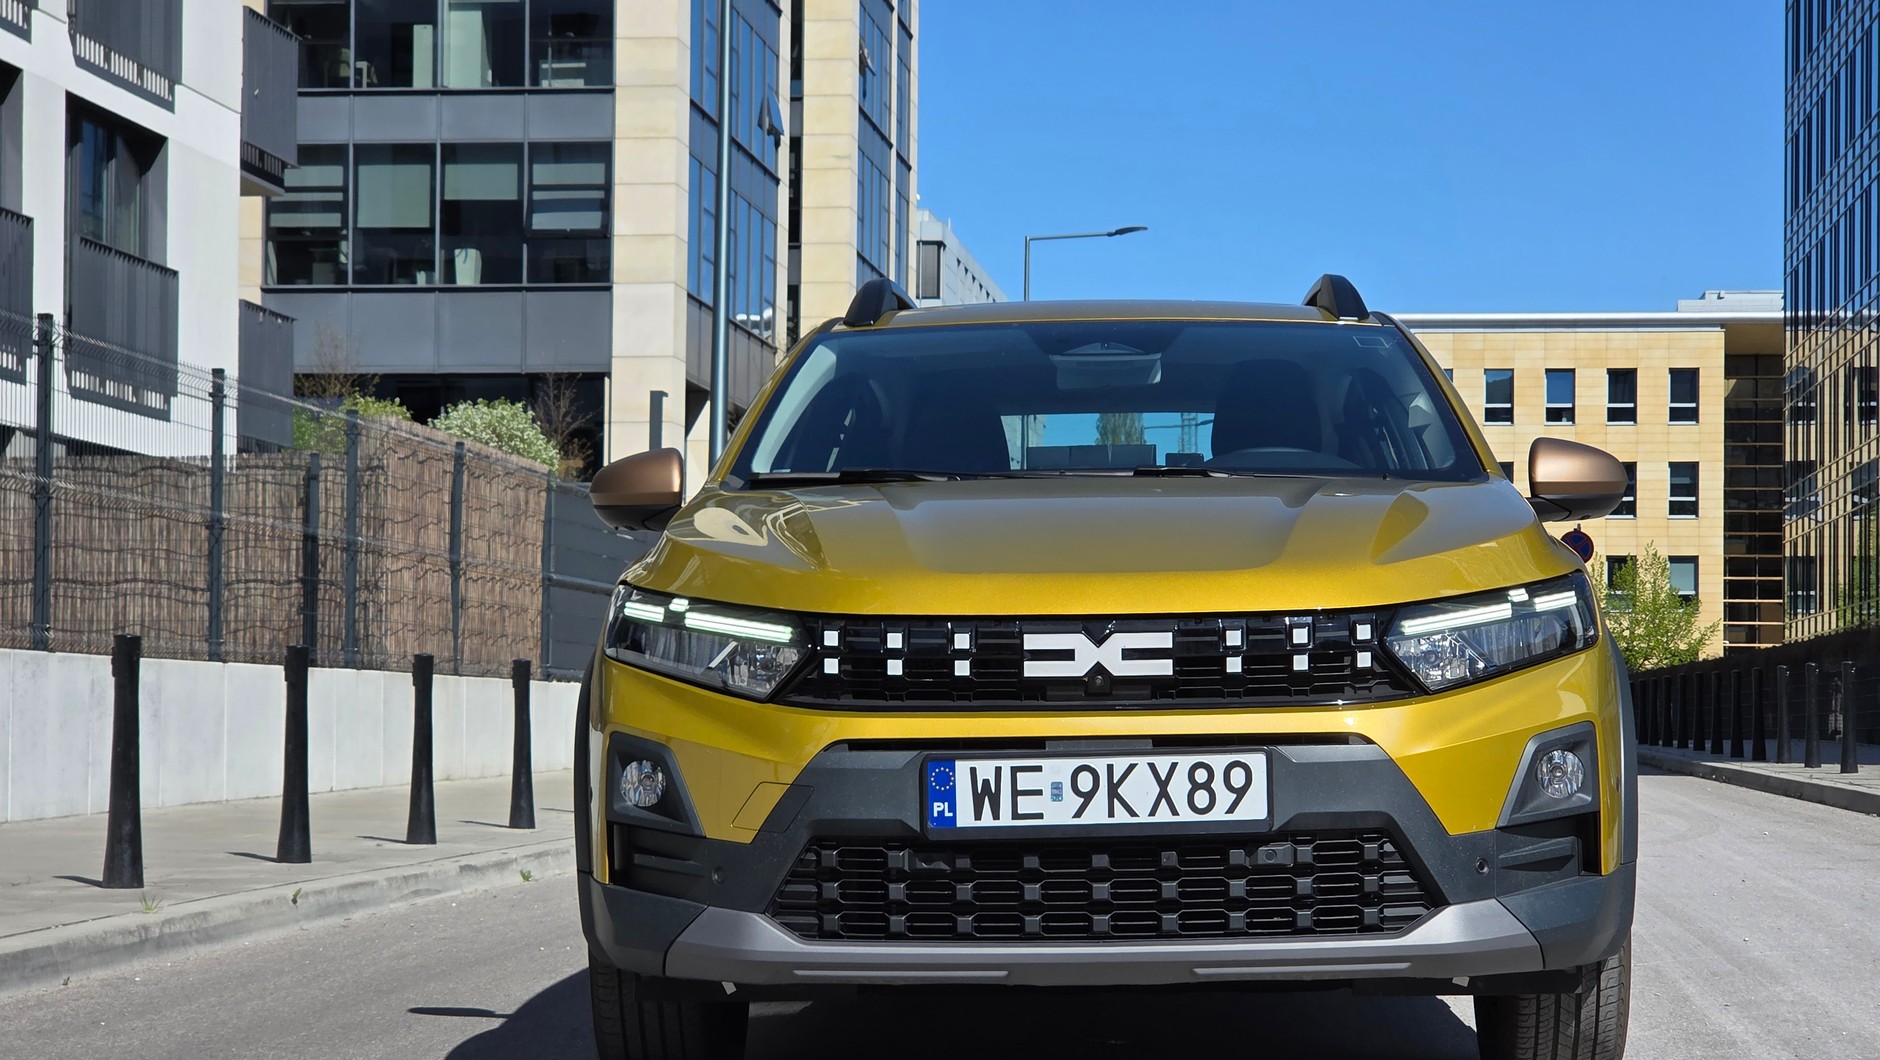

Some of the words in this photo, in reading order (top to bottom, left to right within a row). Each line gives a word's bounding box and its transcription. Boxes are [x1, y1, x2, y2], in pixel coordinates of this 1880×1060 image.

[933, 801, 953, 817] PL
[969, 765, 1044, 821] WE
[1070, 760, 1253, 819] 9KX89
